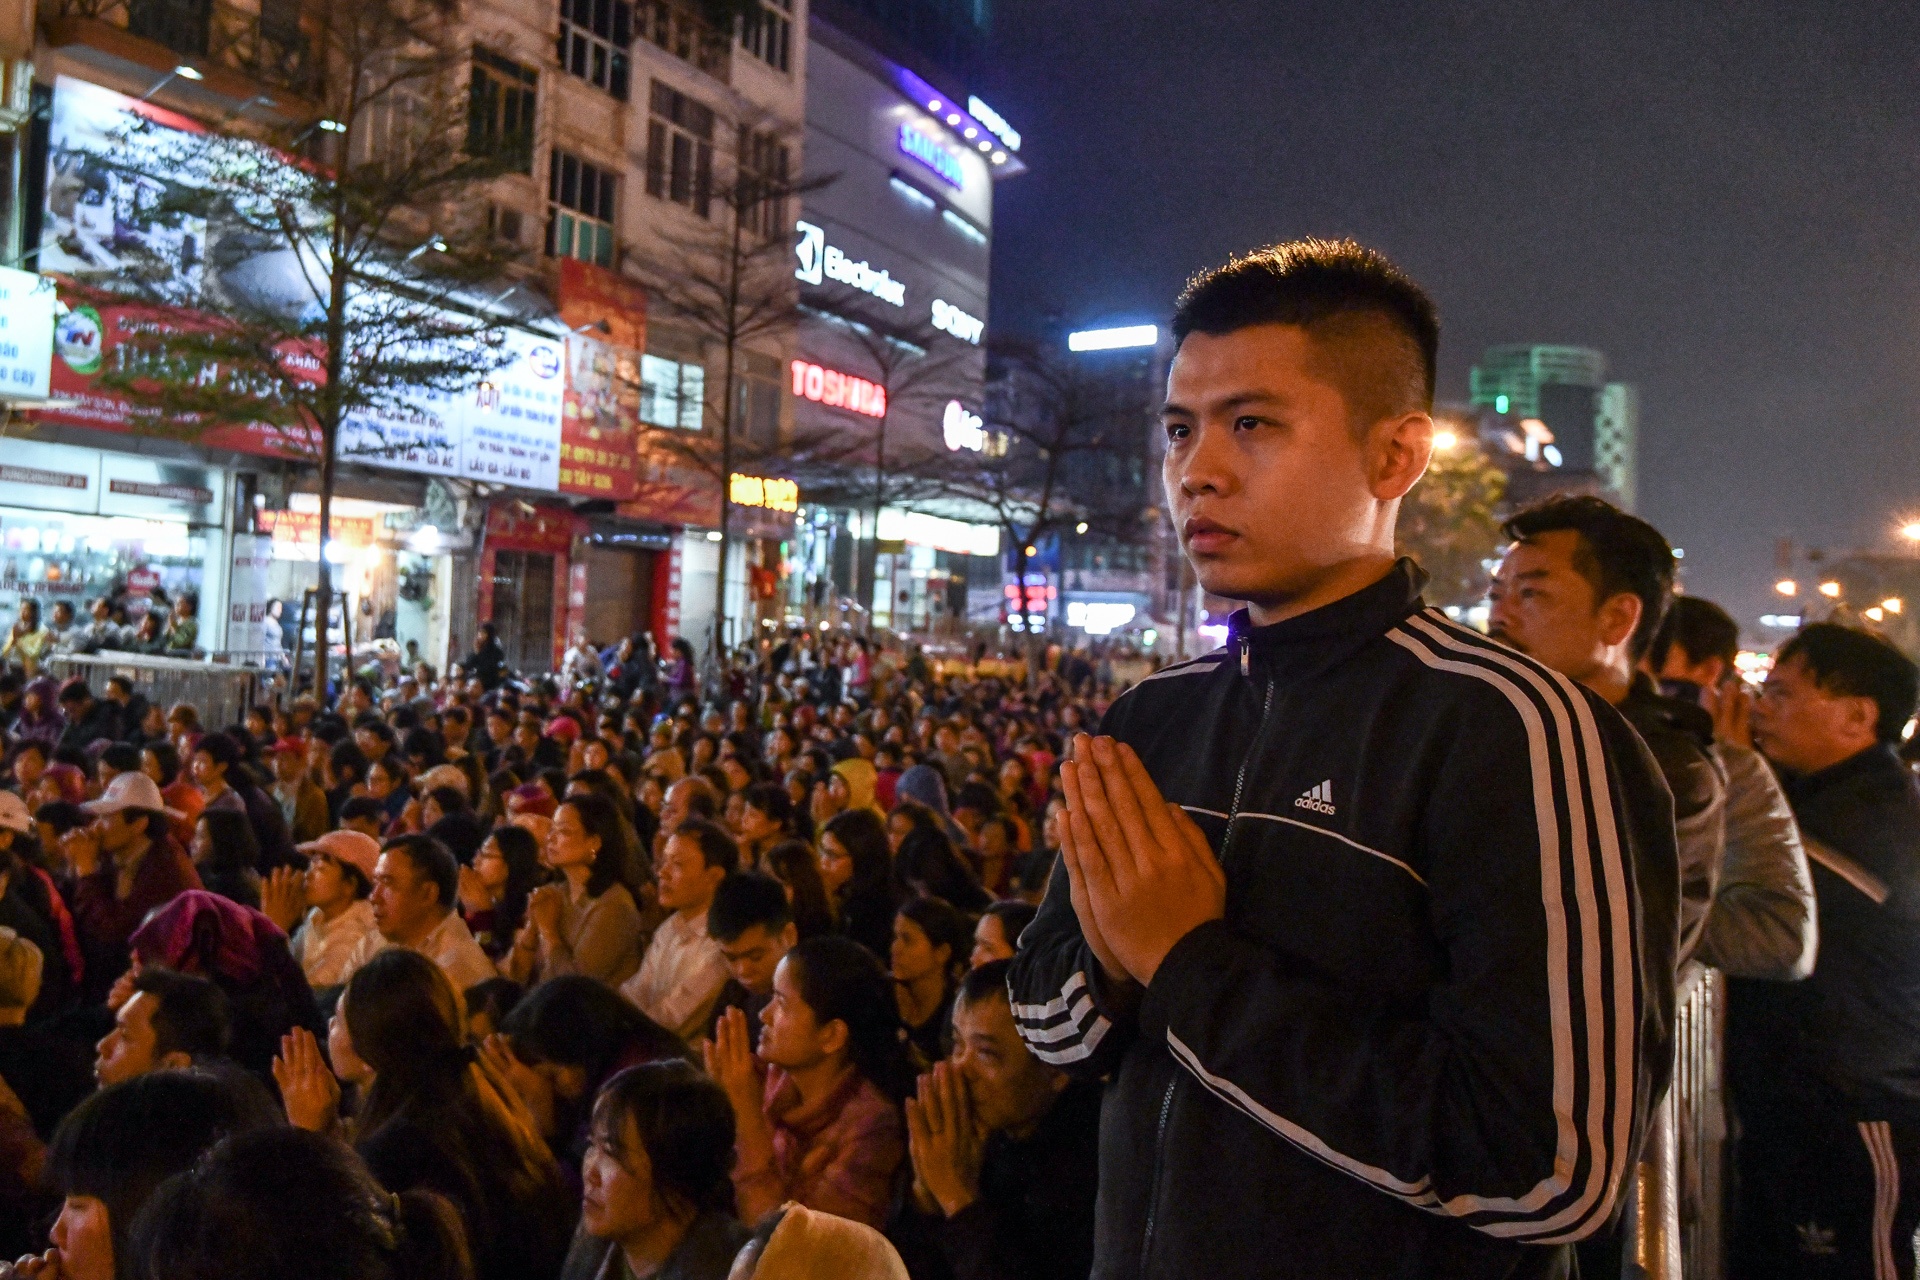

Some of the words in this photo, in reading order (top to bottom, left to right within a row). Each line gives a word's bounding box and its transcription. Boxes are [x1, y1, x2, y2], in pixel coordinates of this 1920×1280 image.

[824, 245, 905, 307] Electrolux
[931, 298, 984, 345] SONY
[791, 360, 886, 418] TOSHIBA
[1294, 796, 1337, 816] adidas
